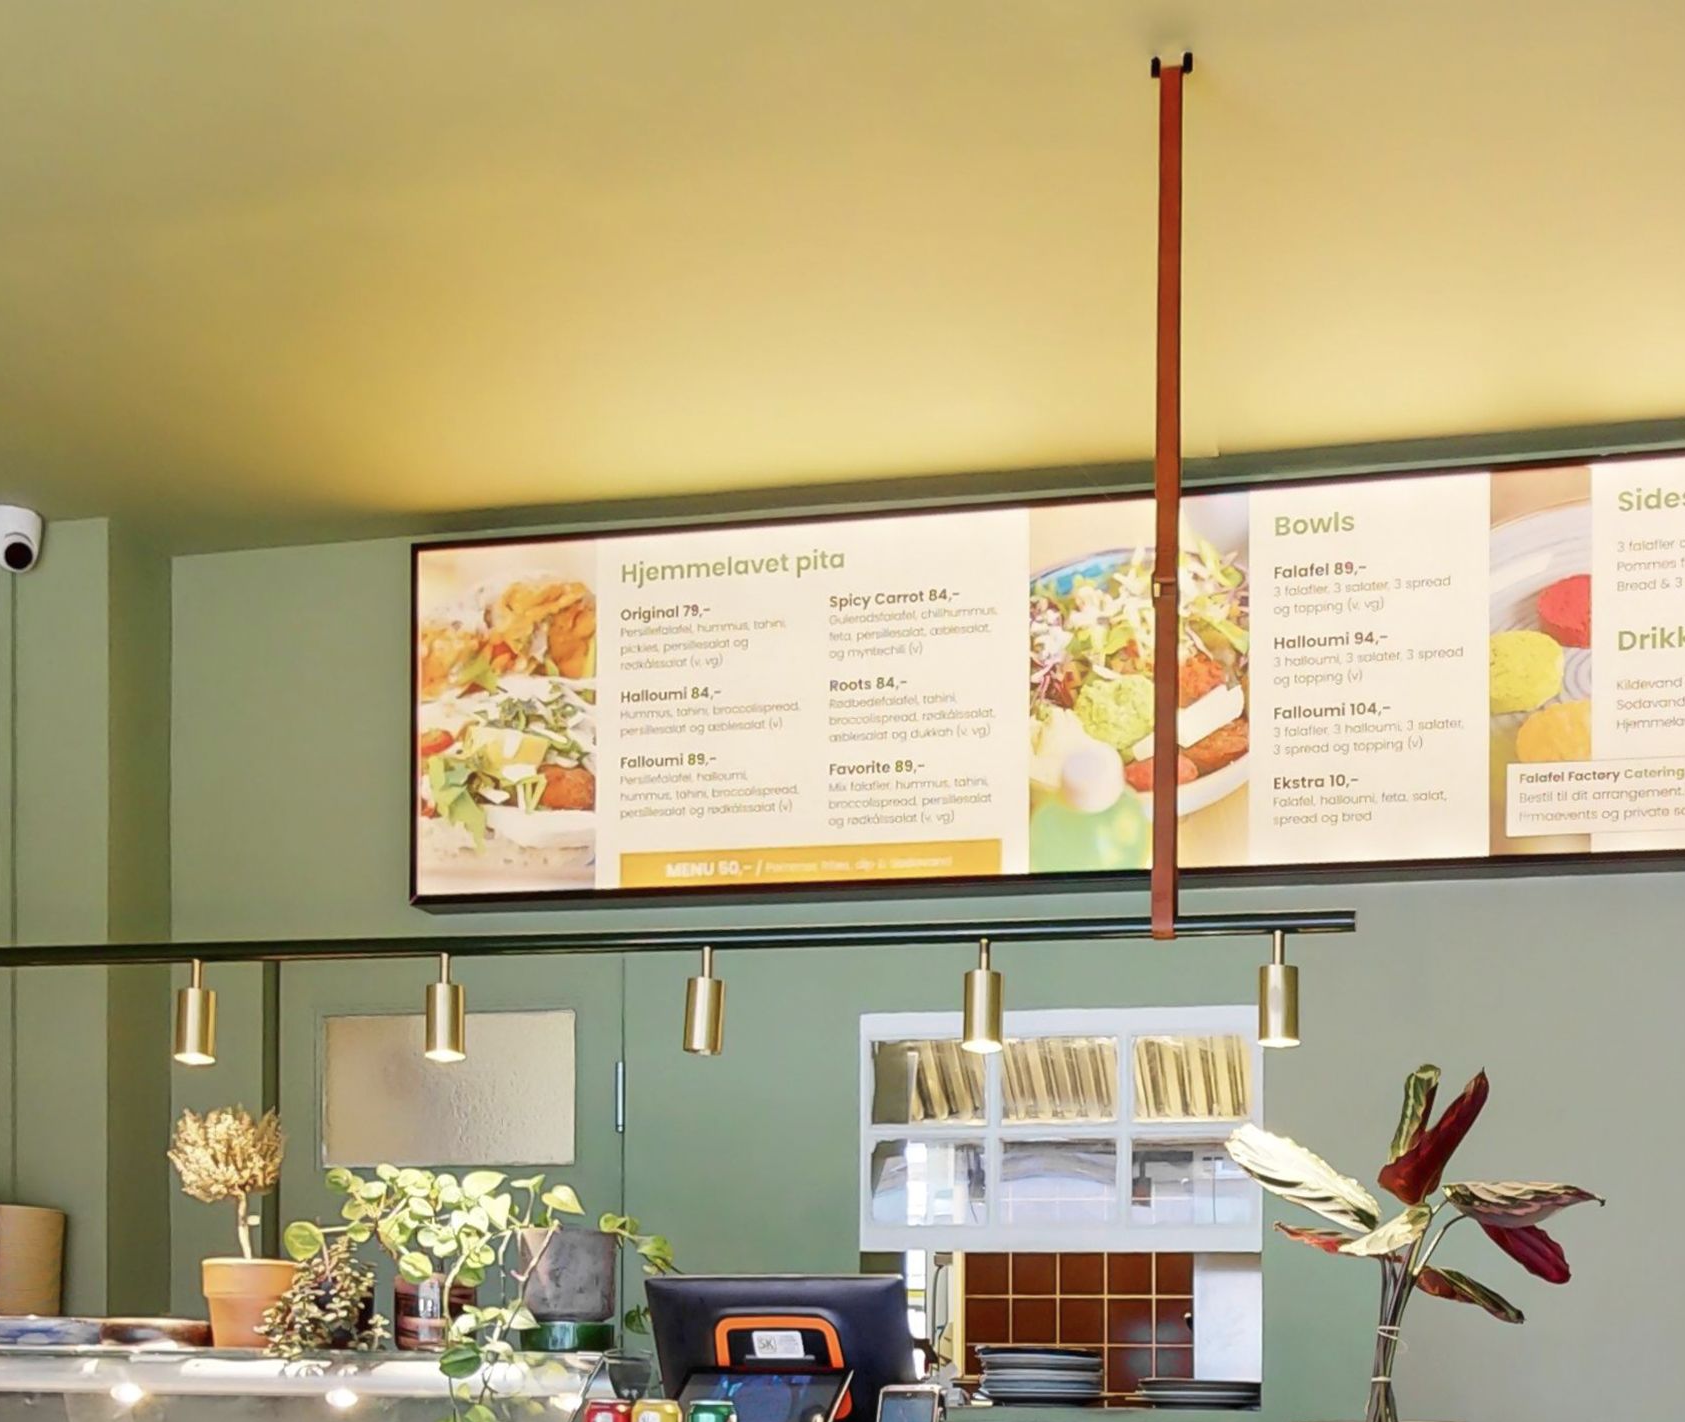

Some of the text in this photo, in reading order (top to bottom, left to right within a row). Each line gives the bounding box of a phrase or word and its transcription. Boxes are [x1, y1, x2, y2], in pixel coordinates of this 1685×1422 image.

[1275, 512, 1354, 536] Bowls
[1617, 541, 1625, 552] 3
[622, 549, 845, 588] Hjemmelavet pita
[1274, 563, 1329, 579] Falafel
[1617, 560, 1676, 572] Pommes
[1274, 587, 1281, 597] 3
[1334, 583, 1341, 593] 3
[1394, 579, 1402, 589] 3
[1406, 576, 1451, 590] spread
[1617, 578, 1656, 592] Bread
[1660, 578, 1671, 589] &
[1675, 577, 1683, 588] 3
[830, 593, 871, 611] Spicy
[875, 591, 924, 605] Carrot
[1274, 606, 1290, 617] og
[1294, 600, 1343, 615] topping
[621, 606, 679, 623] Original
[734, 638, 748, 649] og
[1274, 632, 1349, 649] Halloumi
[829, 649, 844, 661] og
[1274, 657, 1281, 667] 3
[1346, 653, 1353, 663] 3
[1407, 649, 1414, 659] 3
[1418, 647, 1463, 661] spread
[830, 678, 871, 691] Roots
[1274, 669, 1362, 688] og topping (v)
[1616, 677, 1682, 690] Kildevand
[621, 687, 687, 702] Halloumi
[1274, 702, 1391, 720] Falloumi 104,-
[1616, 696, 1685, 711] Sodavand
[690, 725, 704, 735] og
[769, 718, 783, 729] (v)
[892, 731, 907, 742] og
[910, 727, 953, 739] dukkah
[1274, 727, 1281, 737] 3
[1333, 724, 1341, 734] 3
[1407, 720, 1414, 730] 3
[1274, 736, 1423, 757] 3 spread og topping (v)
[621, 754, 683, 768] Falloumi
[829, 761, 890, 775] Favorite
[1274, 774, 1358, 790] Ekstra 10,-
[1519, 767, 1685, 784] Falafel Factory Catering
[829, 782, 846, 792] Mix
[1519, 791, 1553, 804] Bestil
[1557, 791, 1567, 802] til
[1572, 789, 1588, 802] dit
[690, 807, 704, 817] og
[779, 800, 792, 812] (v)
[1602, 808, 1619, 821] og
[1623, 805, 1669, 820] private
[829, 816, 844, 828] og
[1273, 811, 1372, 827] spread og brød
[665, 862, 714, 878] MENU
